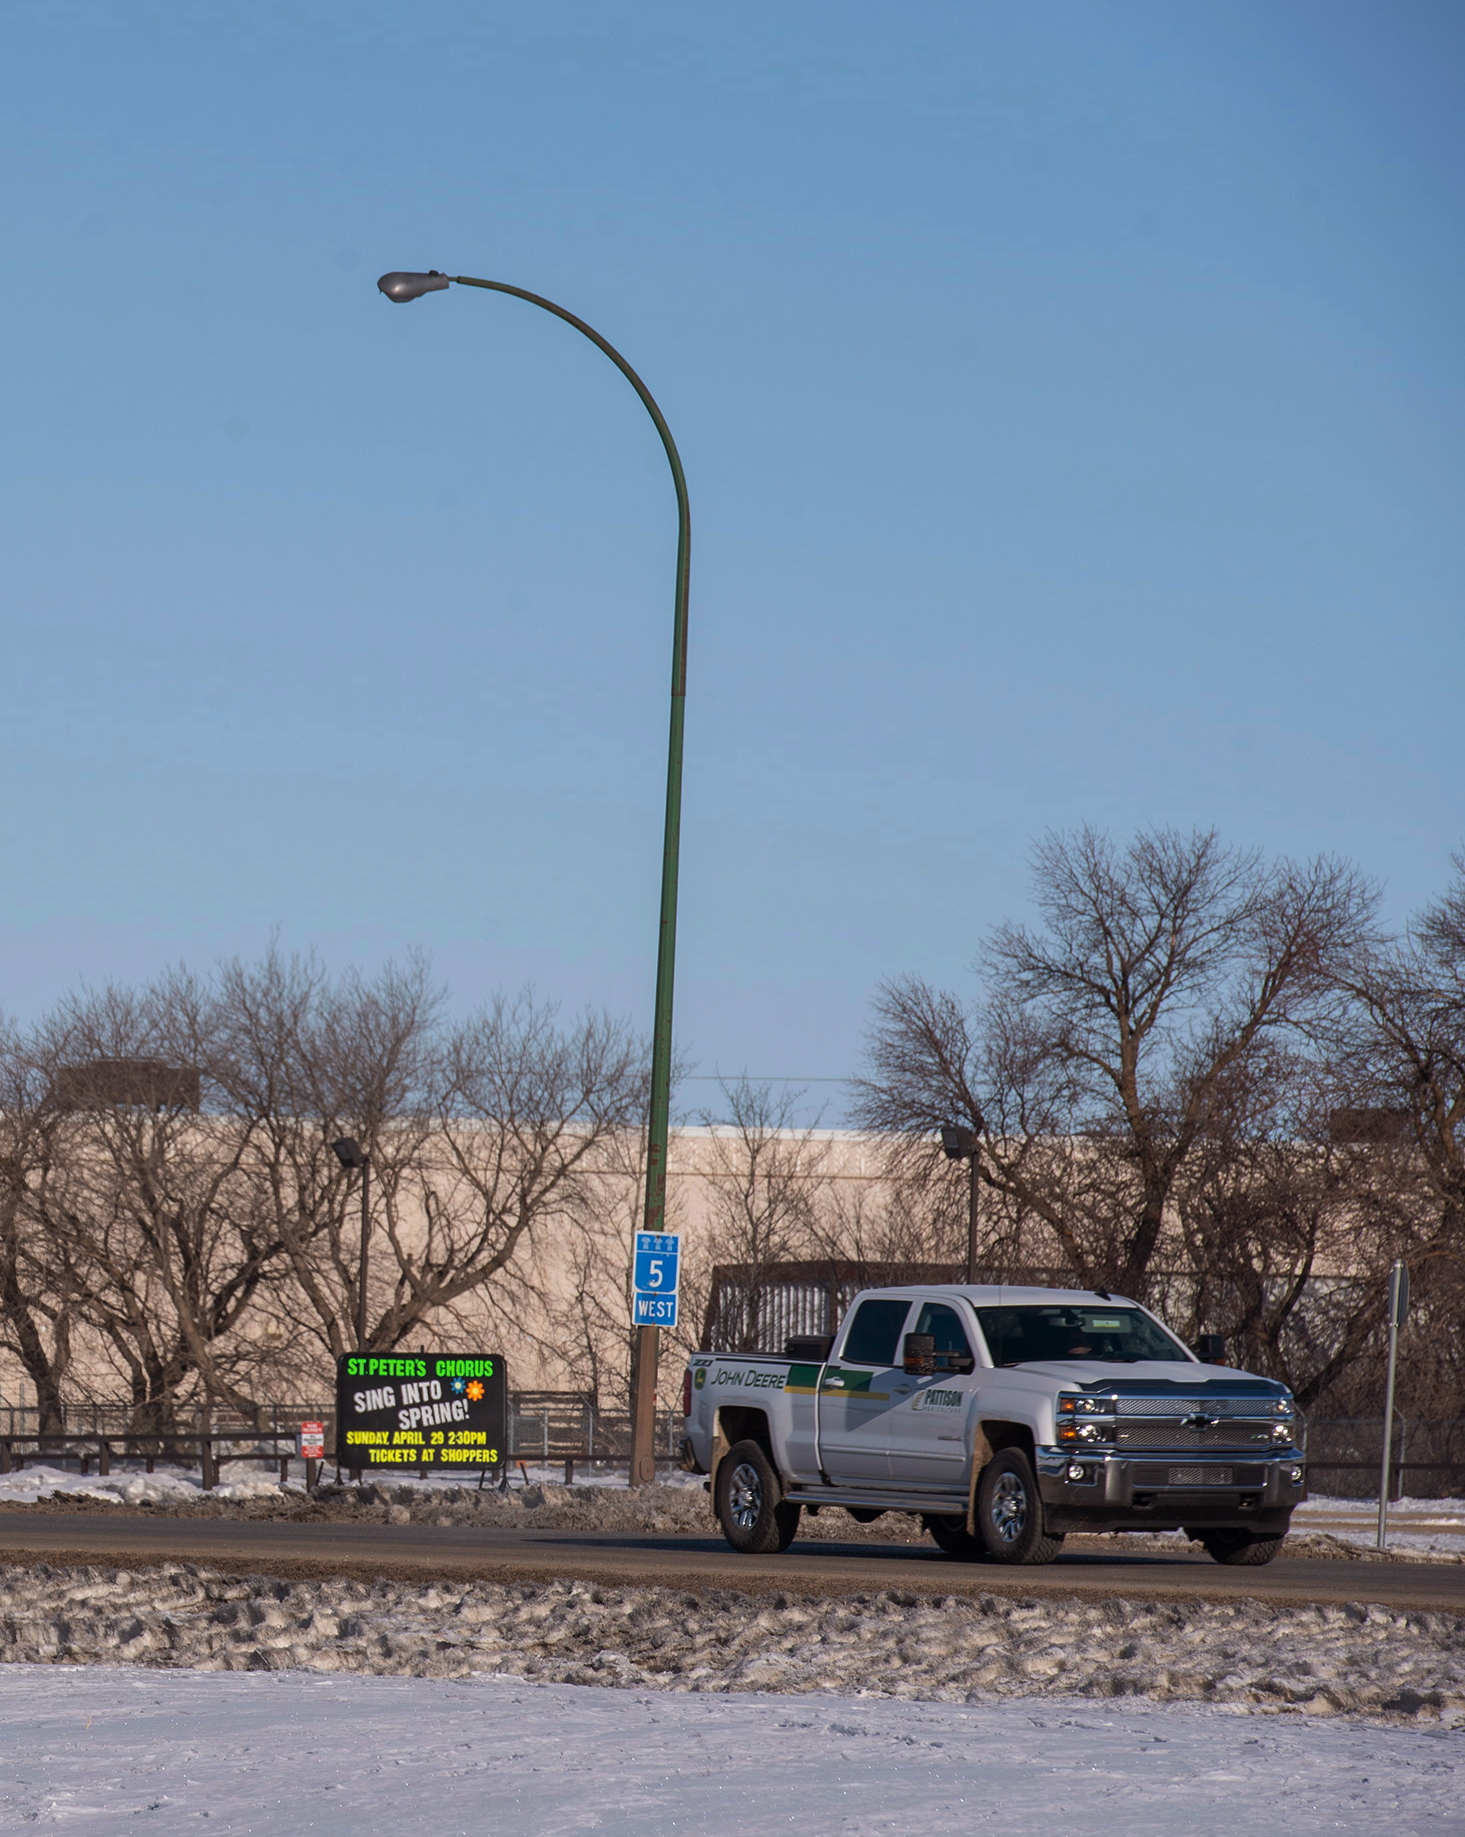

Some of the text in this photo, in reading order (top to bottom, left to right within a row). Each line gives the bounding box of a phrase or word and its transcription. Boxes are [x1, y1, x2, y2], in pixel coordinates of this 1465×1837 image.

[648, 1260, 663, 1288] 5
[638, 1300, 674, 1318] WEST
[435, 1360, 494, 1377] CHORUS
[711, 1368, 786, 1389] JOHN DEERE
[353, 1380, 442, 1413] SING INTO
[924, 1389, 964, 1407] PATTISON
[398, 1398, 470, 1430] SPRING!
[346, 1431, 389, 1446] SUNDAY,
[392, 1432, 425, 1445] APRIL
[430, 1432, 444, 1445] 29
[369, 1449, 498, 1463] TICKETS AT SHOPPERS
